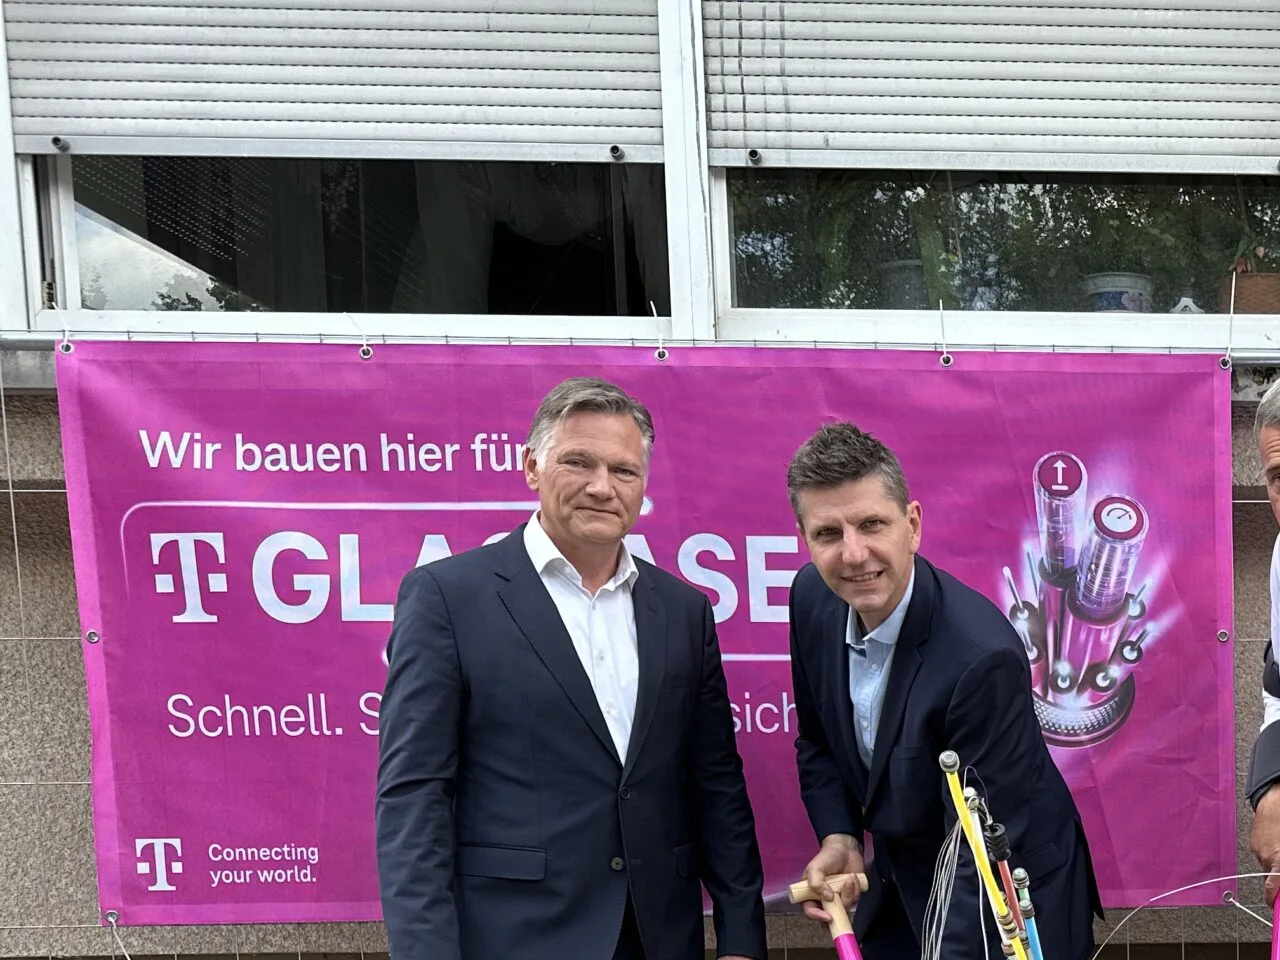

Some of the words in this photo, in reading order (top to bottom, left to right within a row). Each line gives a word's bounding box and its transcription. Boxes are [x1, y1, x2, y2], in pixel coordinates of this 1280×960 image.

[139, 429, 222, 470] Wir
[235, 432, 368, 472] bauen
[380, 432, 461, 472] hier
[470, 433, 526, 472] für
[166, 693, 344, 737] Schnell.
[359, 692, 382, 735] S
[733, 692, 797, 734] sich
[208, 843, 319, 863] Connecting
[209, 868, 253, 887] your
[257, 865, 317, 883] world.
